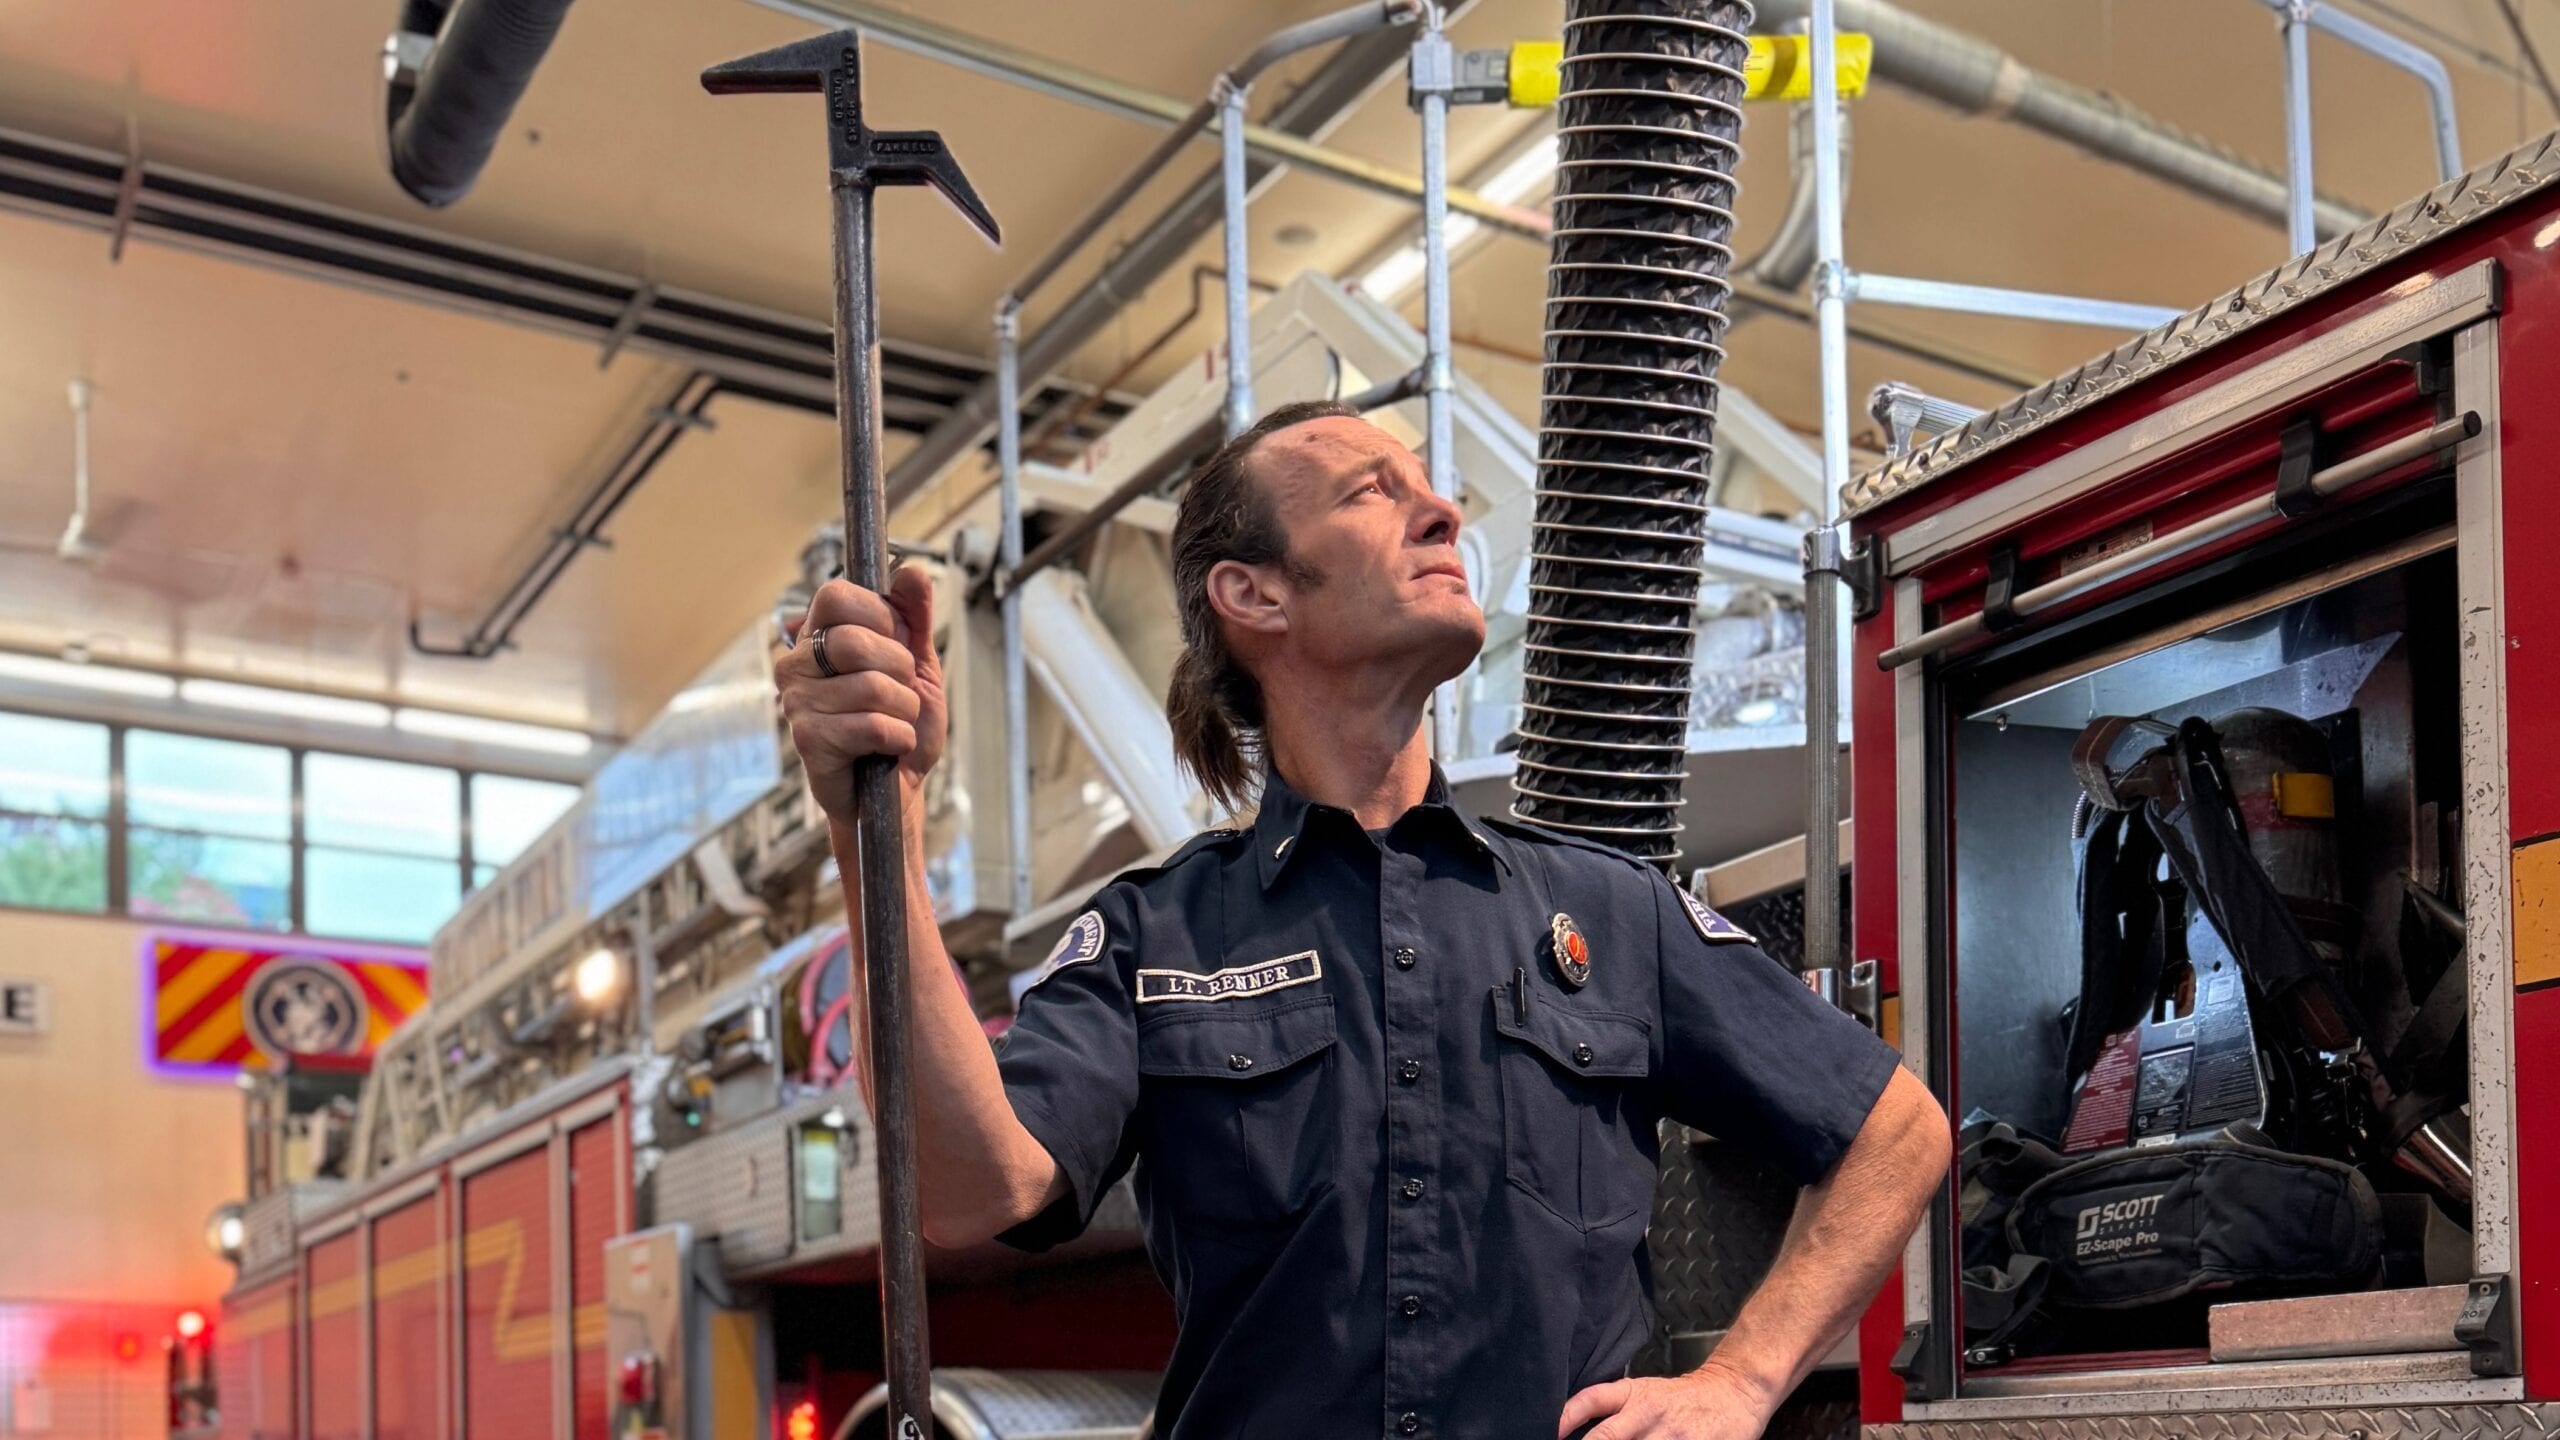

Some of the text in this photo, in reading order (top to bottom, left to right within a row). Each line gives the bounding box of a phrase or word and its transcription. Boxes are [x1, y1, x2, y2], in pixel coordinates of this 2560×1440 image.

[1168, 966, 1290, 995] LT. RENNER
[2101, 1194, 2164, 1224] SCOTT
[2076, 1231, 2159, 1256] EZ-Scape Pro
